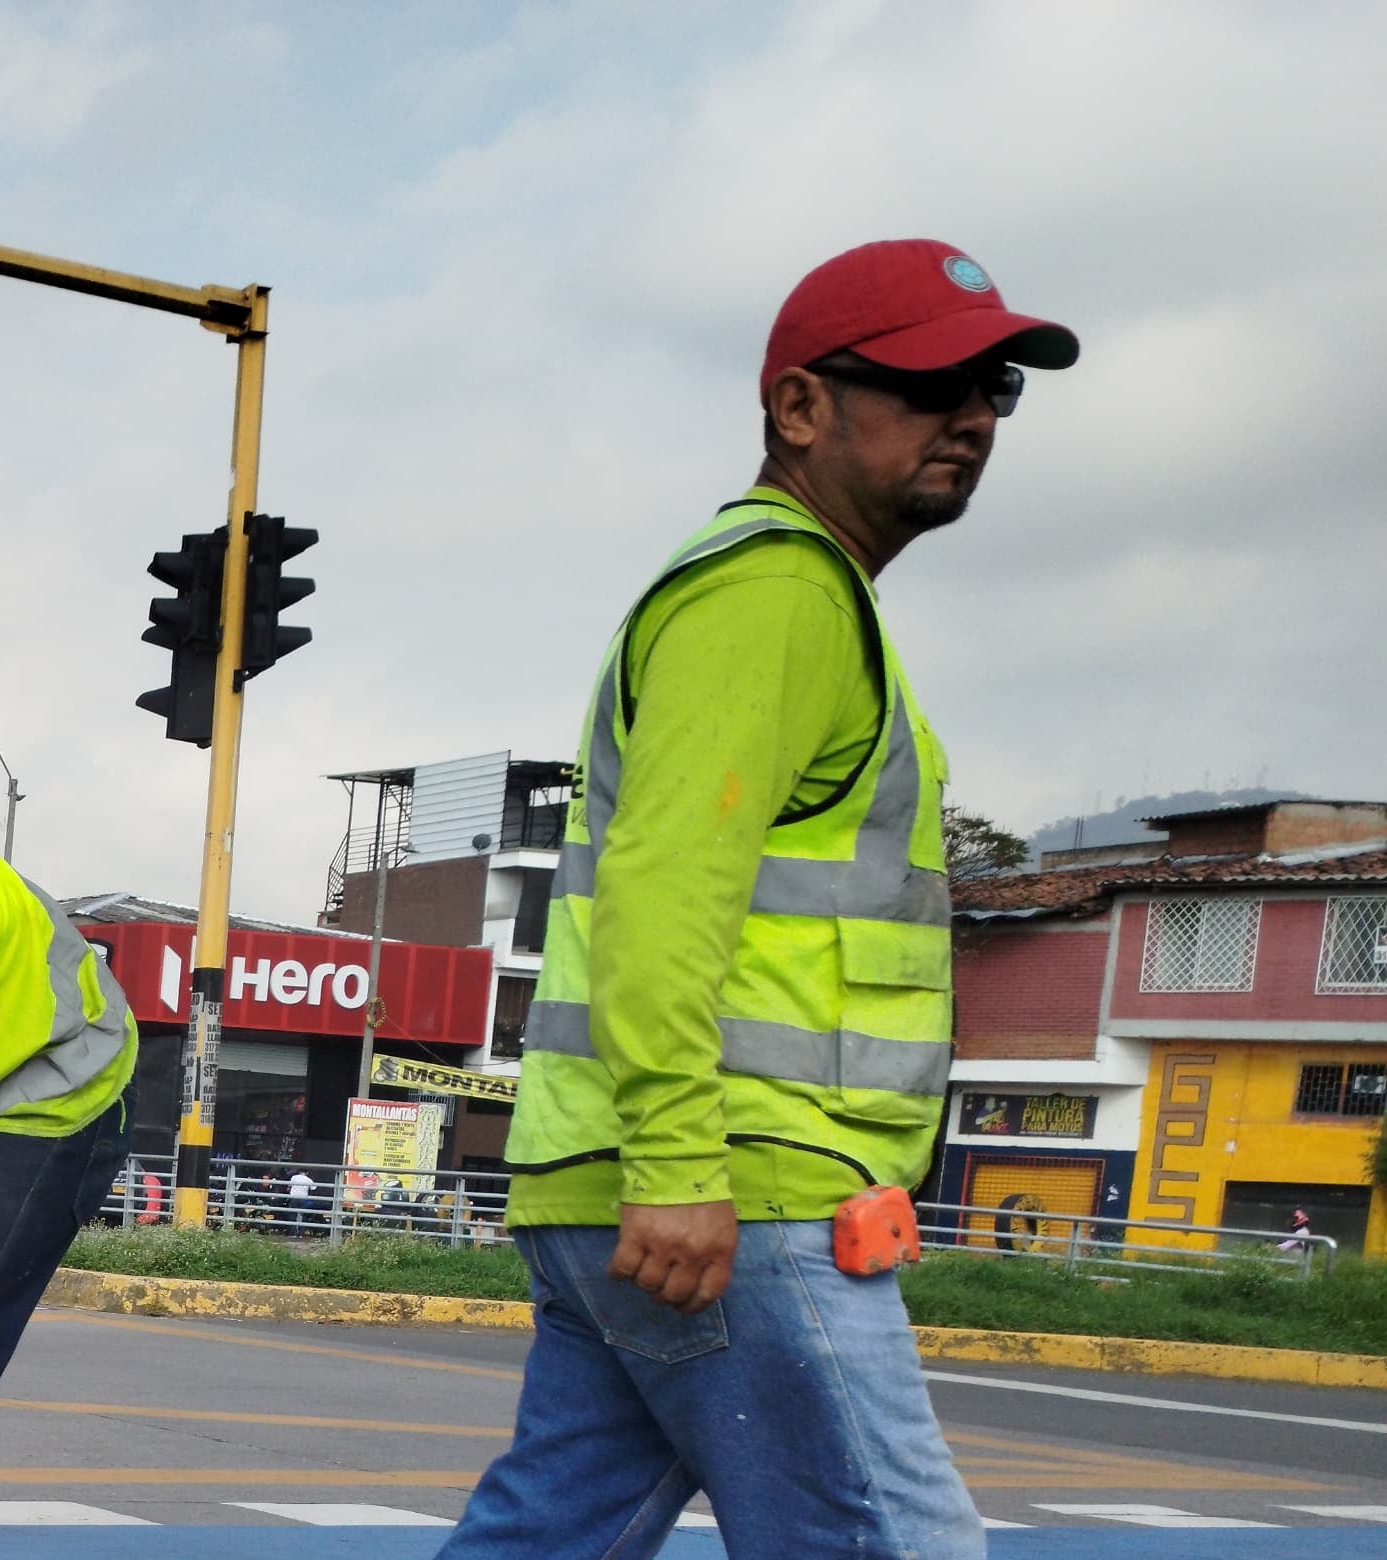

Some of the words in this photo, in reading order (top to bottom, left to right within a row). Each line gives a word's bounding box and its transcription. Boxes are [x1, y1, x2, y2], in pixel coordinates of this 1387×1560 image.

[229, 956, 370, 1010] Hero
[352, 1103, 418, 1122] MONTALLANTAS
[1022, 1108, 1084, 1123] PINTURA
